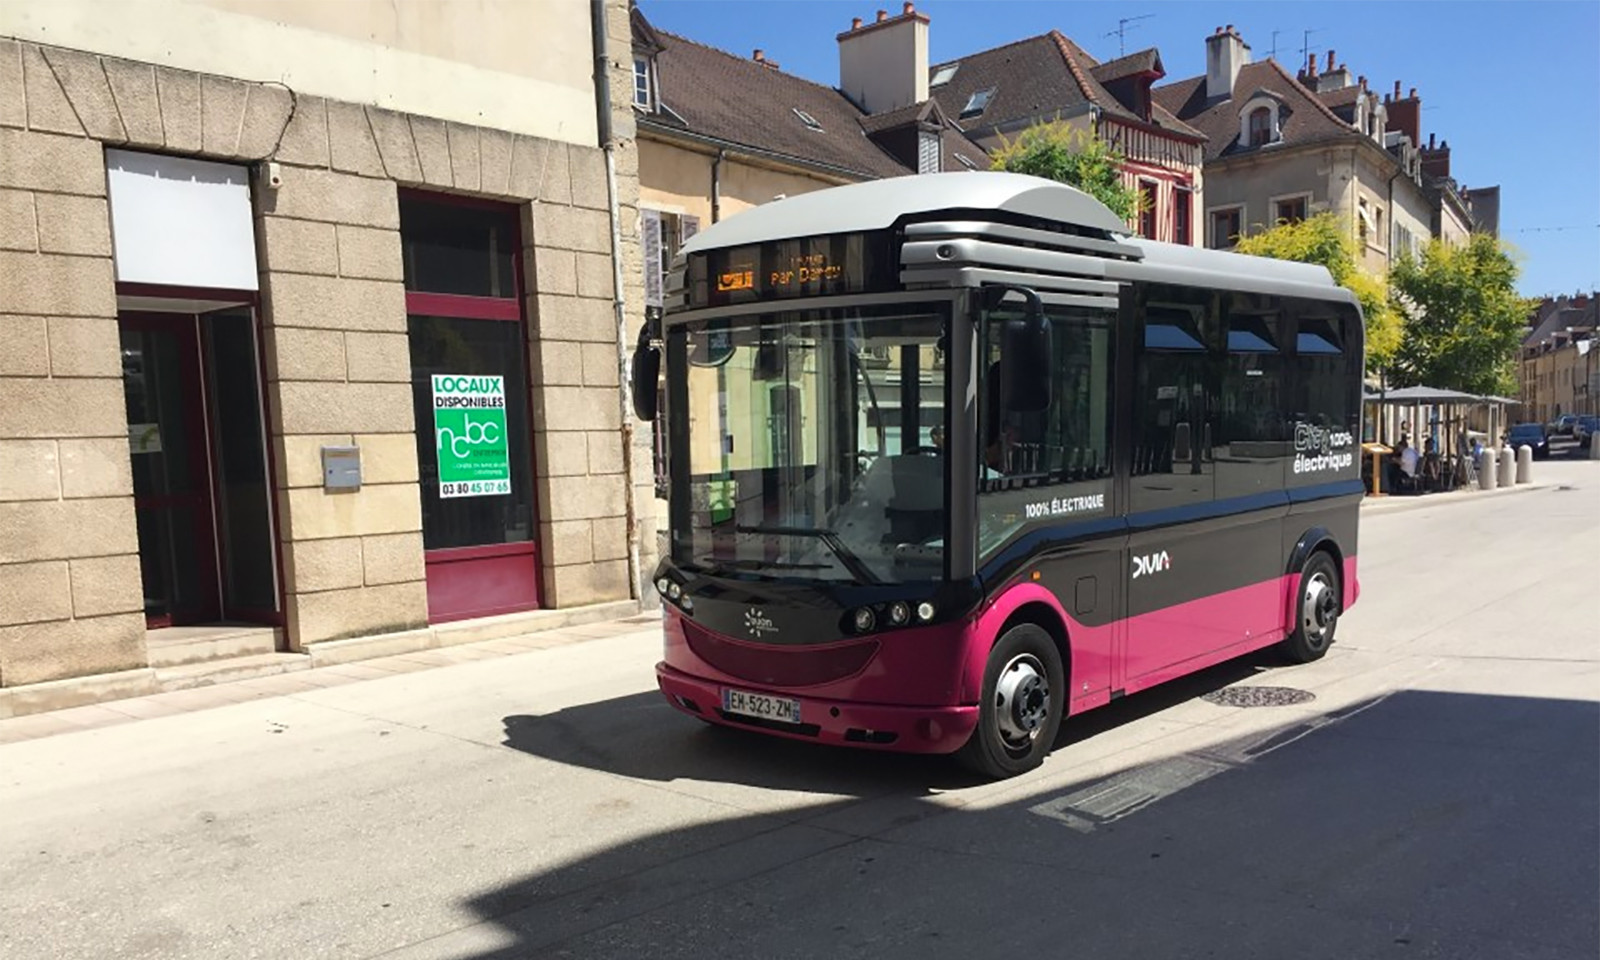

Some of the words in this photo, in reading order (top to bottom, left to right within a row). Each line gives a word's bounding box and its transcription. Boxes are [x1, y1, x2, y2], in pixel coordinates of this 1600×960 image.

[434, 377, 502, 394] LOCAUX
[436, 397, 504, 408] DISPONIBLES
[1330, 431, 1353, 447] 100%
[1293, 452, 1352, 474] électrique
[443, 484, 455, 495] 03
[457, 483, 469, 494] 80
[471, 483, 482, 493] 45
[485, 482, 495, 492] 07
[1025, 502, 1050, 518] 100%
[1051, 494, 1105, 514] ÉLECTRIQUE
